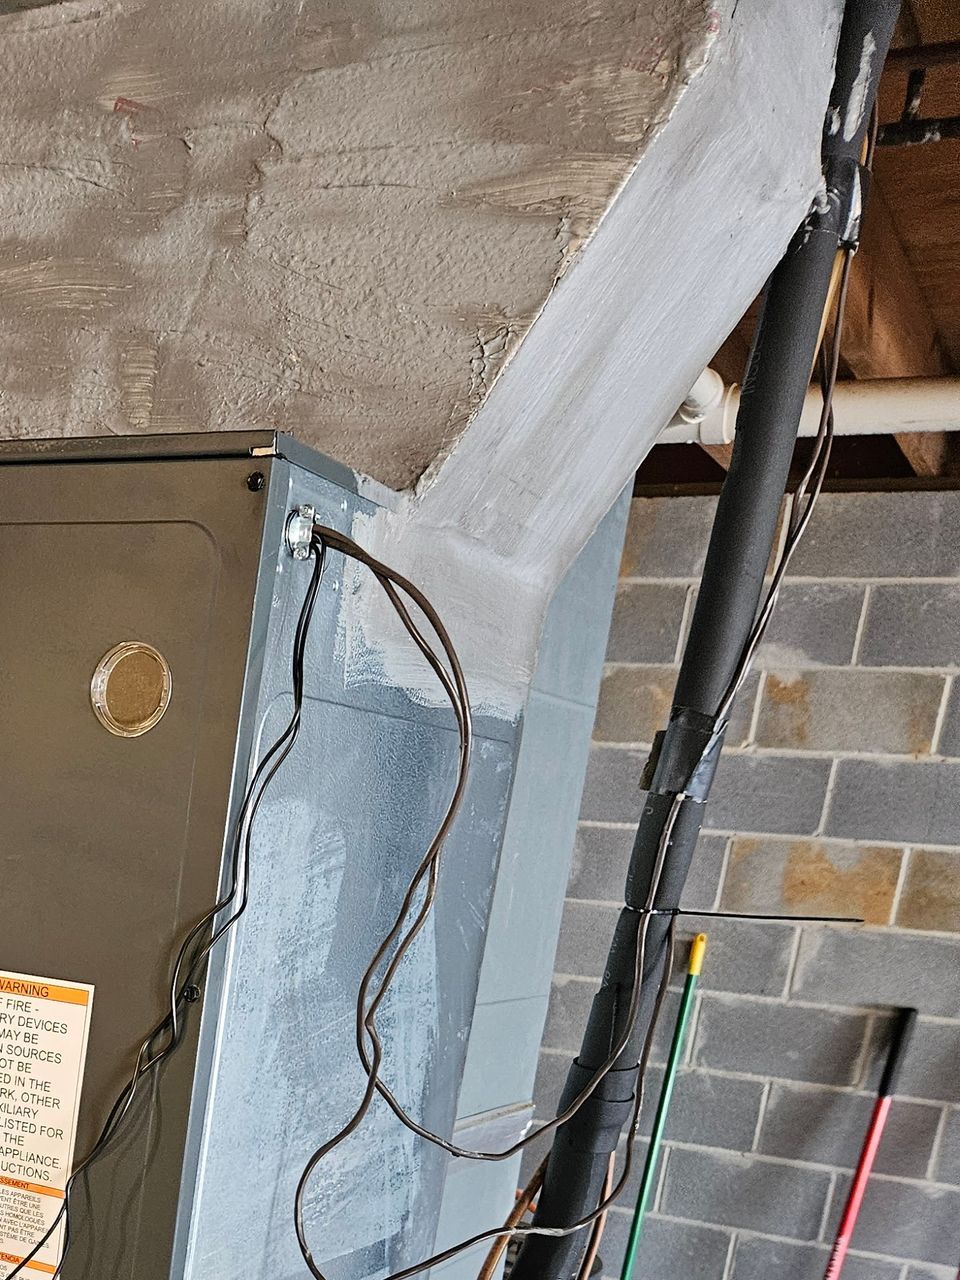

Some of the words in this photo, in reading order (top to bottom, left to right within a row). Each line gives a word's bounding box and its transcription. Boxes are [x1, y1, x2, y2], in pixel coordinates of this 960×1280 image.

[6, 998, 31, 1013] FIRE
[17, 1015, 68, 1034] DEVICES
[23, 1032, 38, 1044] BE
[6, 1043, 62, 1064] SOURCES
[16, 1061, 31, 1073] BE
[14, 1075, 25, 1087] IN
[28, 1078, 51, 1092] THE
[20, 1091, 60, 1109] OTHER
[2, 1132, 24, 1145] THE
[40, 1125, 63, 1139] FOR
